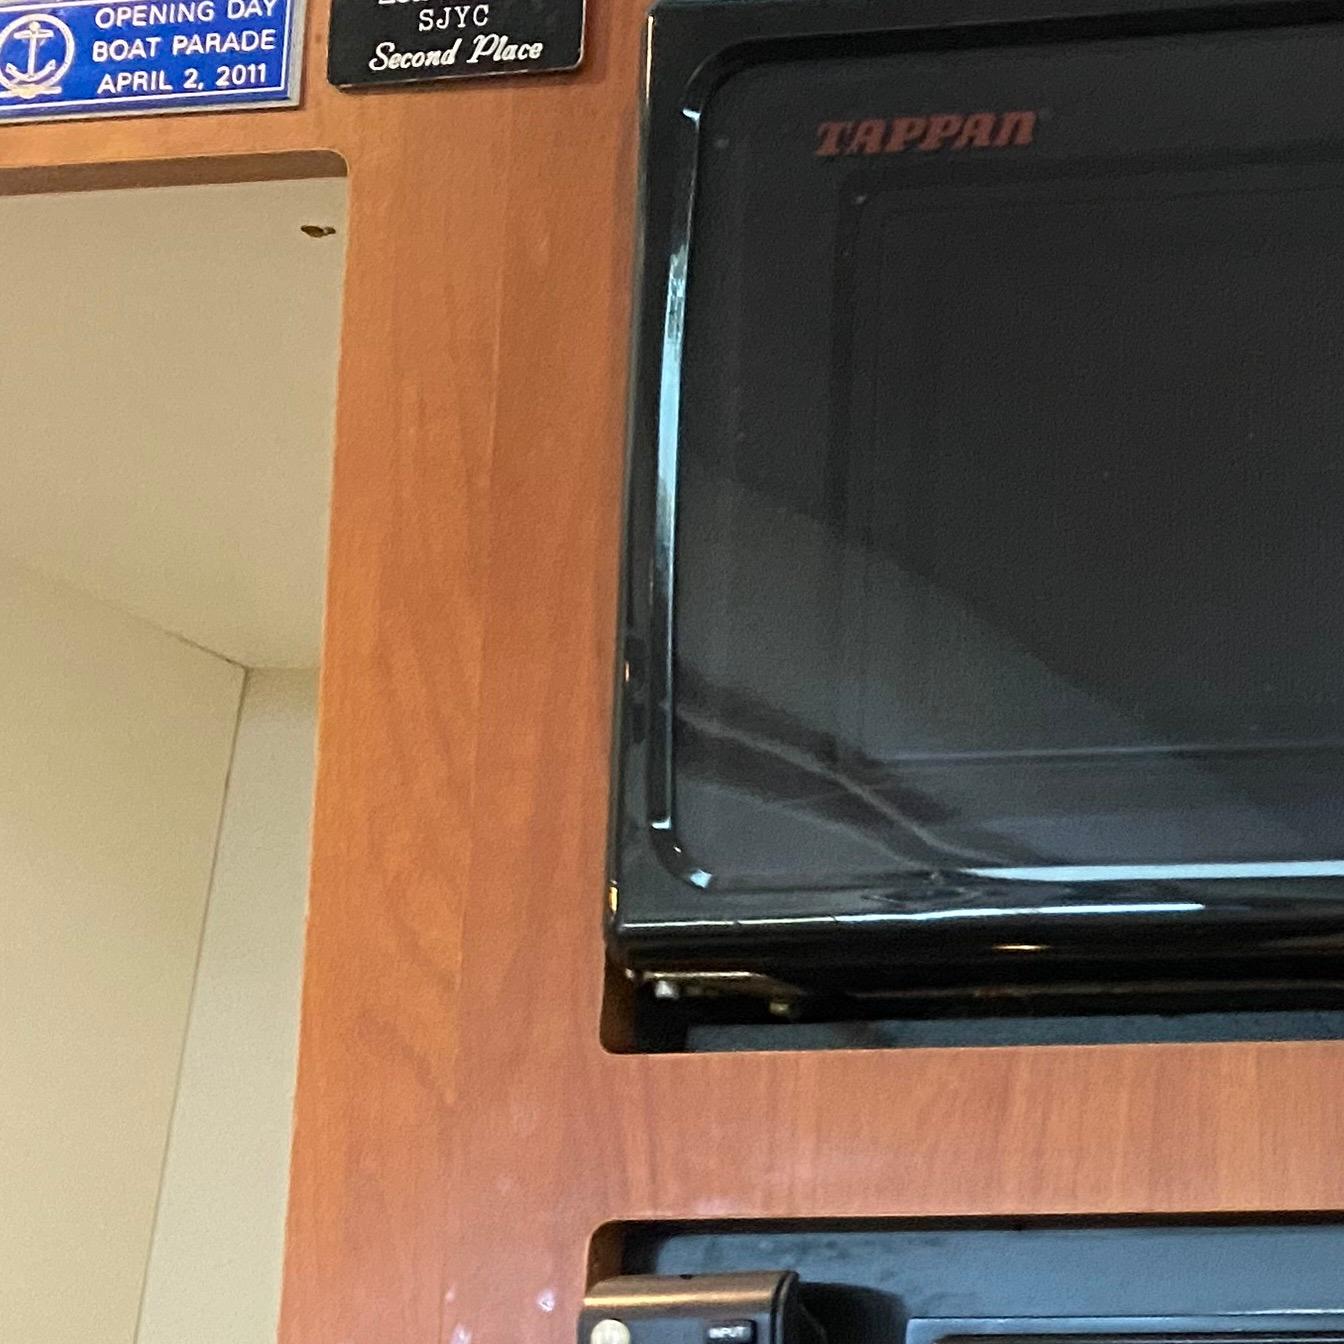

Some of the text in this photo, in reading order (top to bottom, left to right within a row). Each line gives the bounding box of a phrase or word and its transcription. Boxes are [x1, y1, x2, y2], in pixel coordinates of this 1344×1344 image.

[95, 0, 278, 29] OPENING DAY
[419, 5, 489, 31] SJYC
[93, 29, 276, 62] BOAT PARADE
[369, 33, 543, 71] Second Place
[97, 63, 266, 94] APRIL 2, 2011
[815, 110, 1037, 157] TAPPAN
